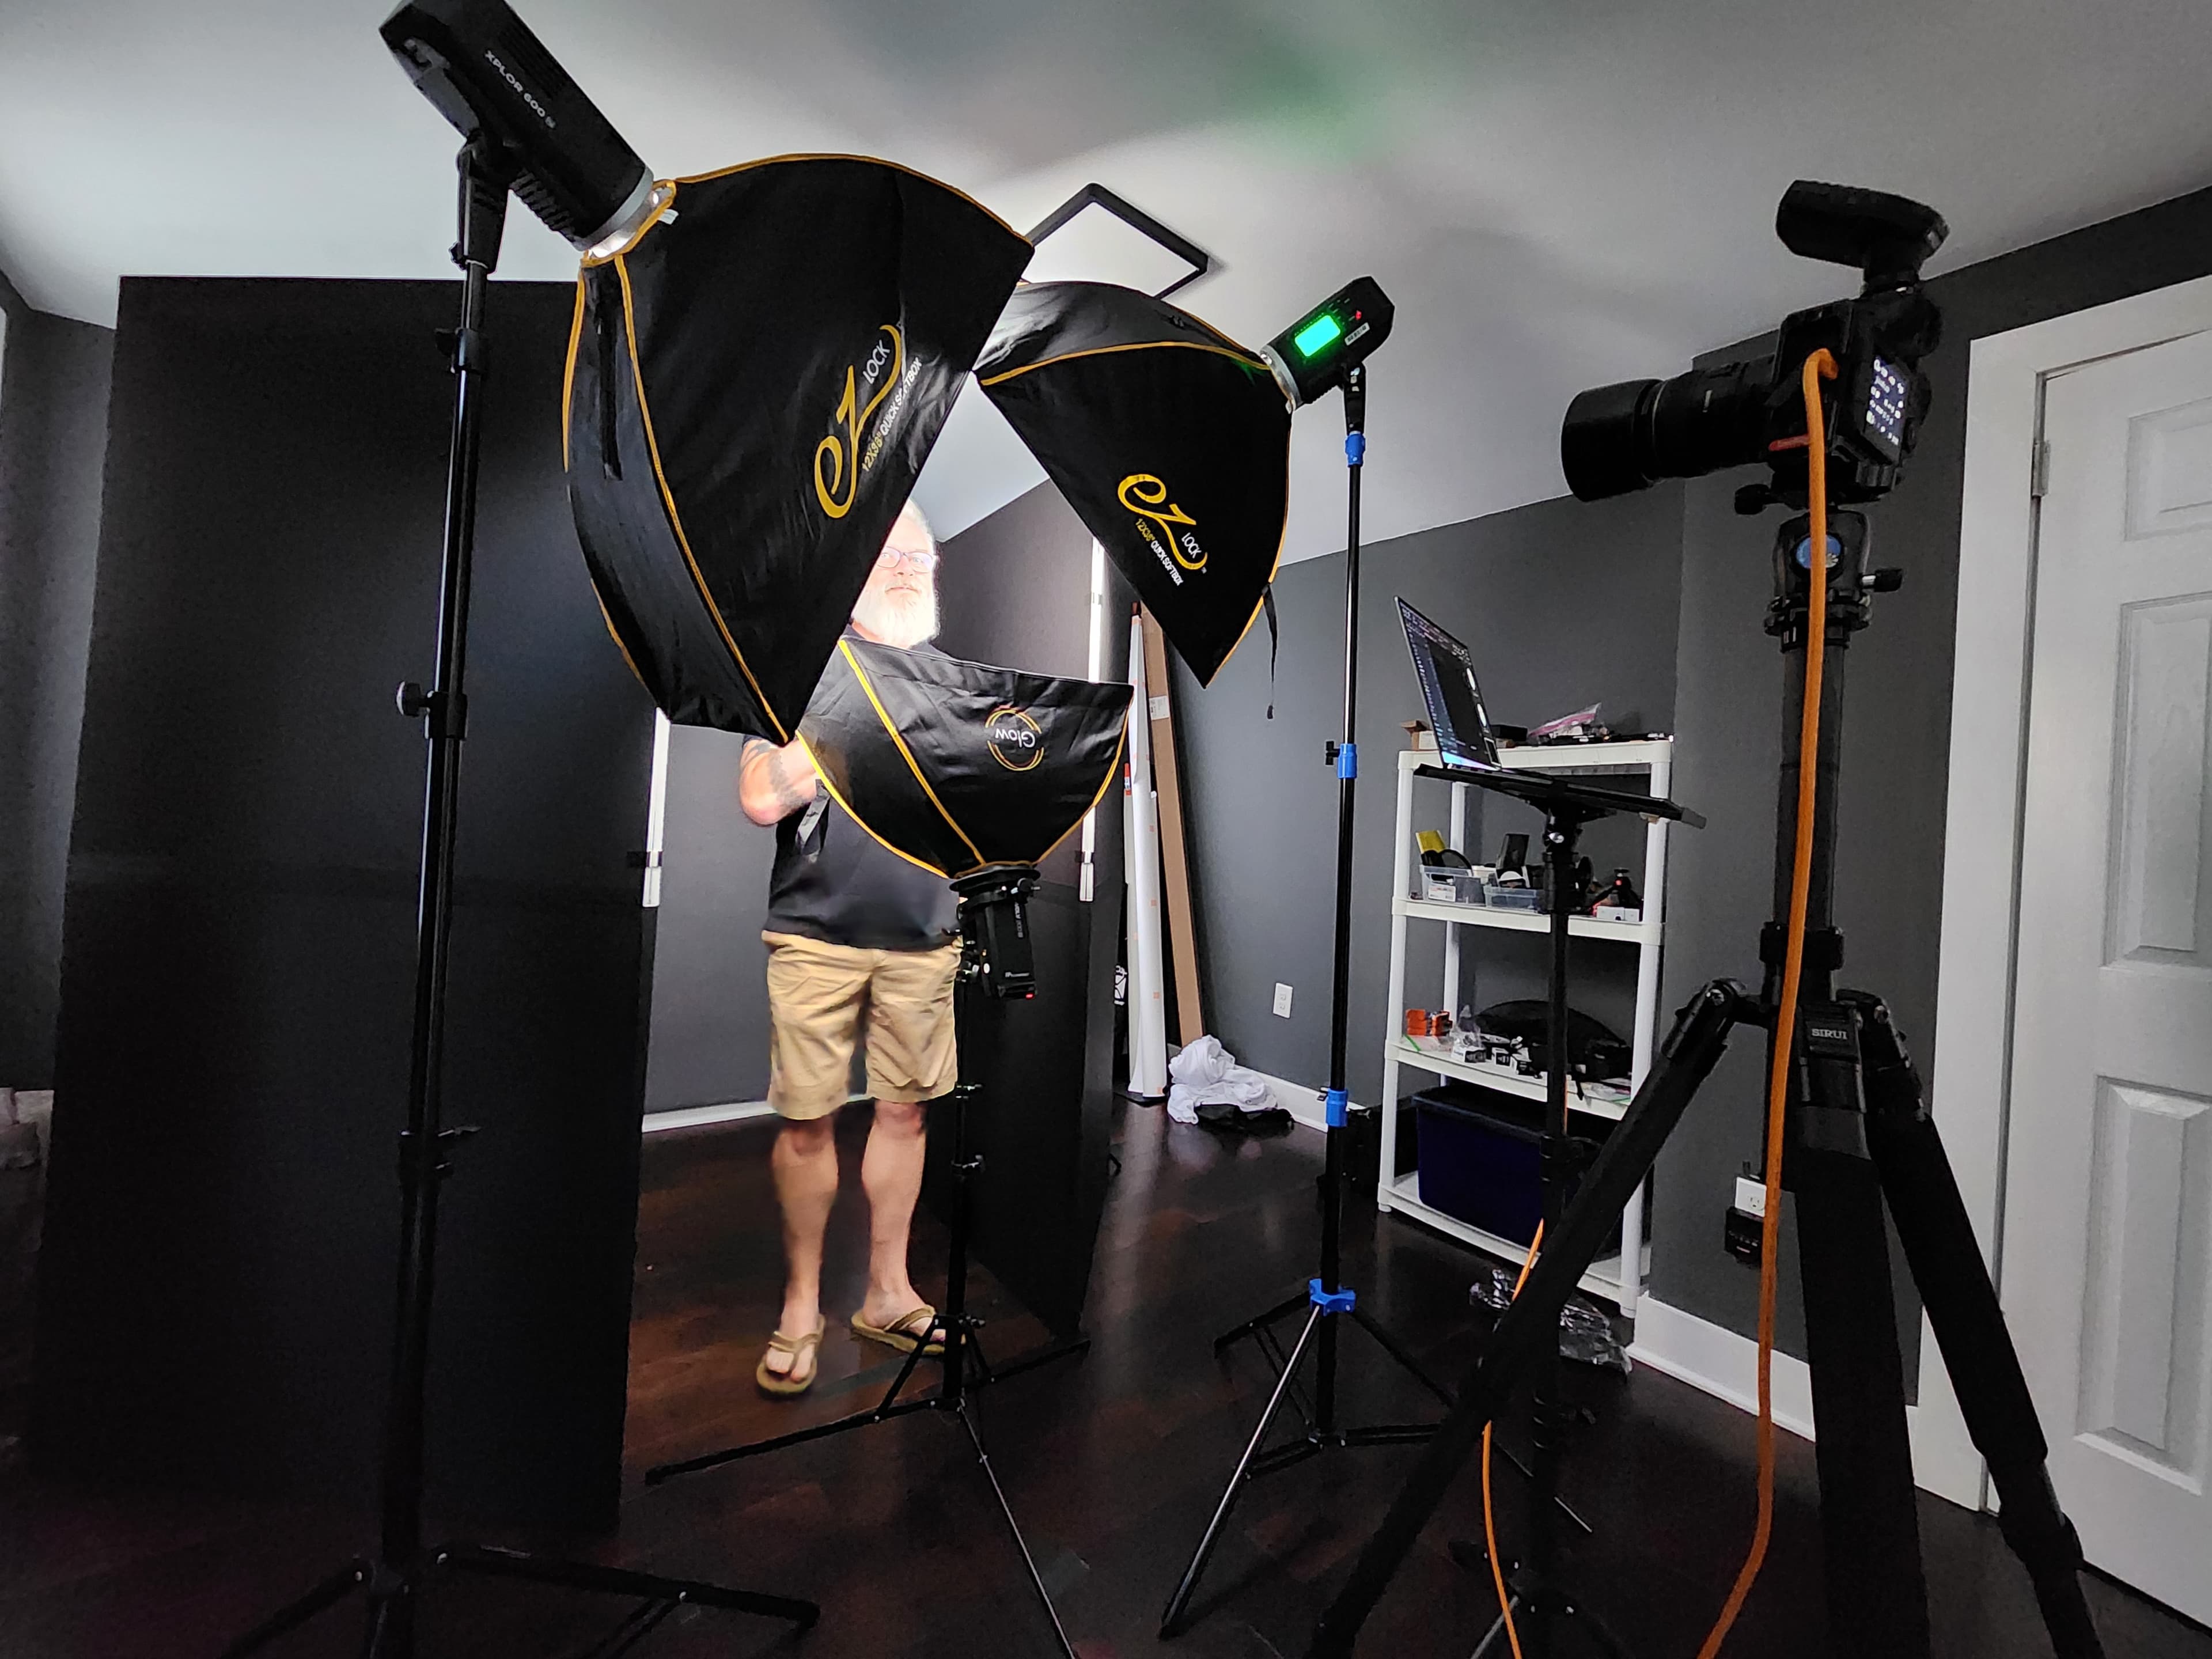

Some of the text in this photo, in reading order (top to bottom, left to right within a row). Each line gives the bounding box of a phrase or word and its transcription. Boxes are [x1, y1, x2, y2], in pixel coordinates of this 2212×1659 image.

[485, 50, 546, 117] XPLOR 600
[863, 340, 891, 385] LOCK
[880, 402, 900, 435] QUICK
[1181, 532, 1202, 558] LOCK
[1150, 540, 1168, 561] QUICK
[1162, 557, 1184, 586] SOFTBOX
[995, 728, 1036, 748] Glow
[1811, 1028, 1847, 1040] SIRUI
